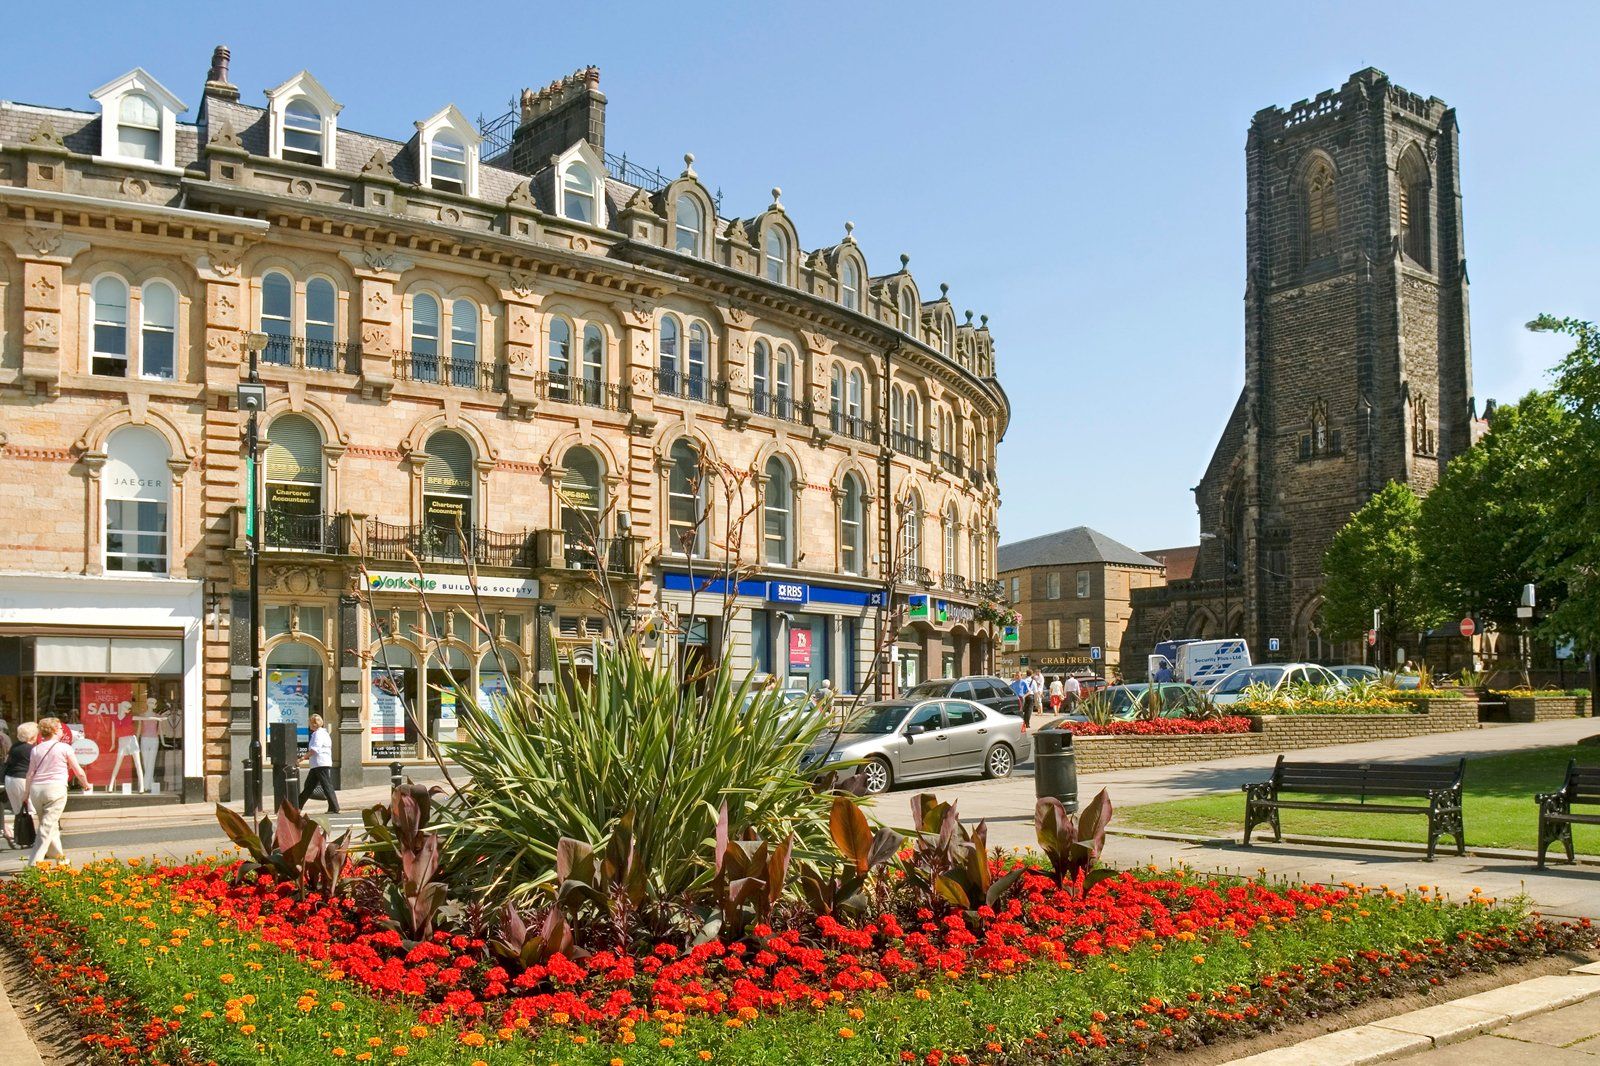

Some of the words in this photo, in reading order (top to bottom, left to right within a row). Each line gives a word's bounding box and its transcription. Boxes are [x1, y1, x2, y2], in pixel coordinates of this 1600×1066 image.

[113, 478, 161, 488] JAEGER
[275, 489, 311, 497] Chartered
[271, 495, 315, 504] Accountants
[432, 501, 463, 509] Chartered
[428, 507, 467, 516] Accountas
[442, 584, 488, 592] BUILDNG
[493, 586, 532, 595] SOCIETY
[787, 585, 803, 598] RBS
[1040, 656, 1094, 665] CRABTREES
